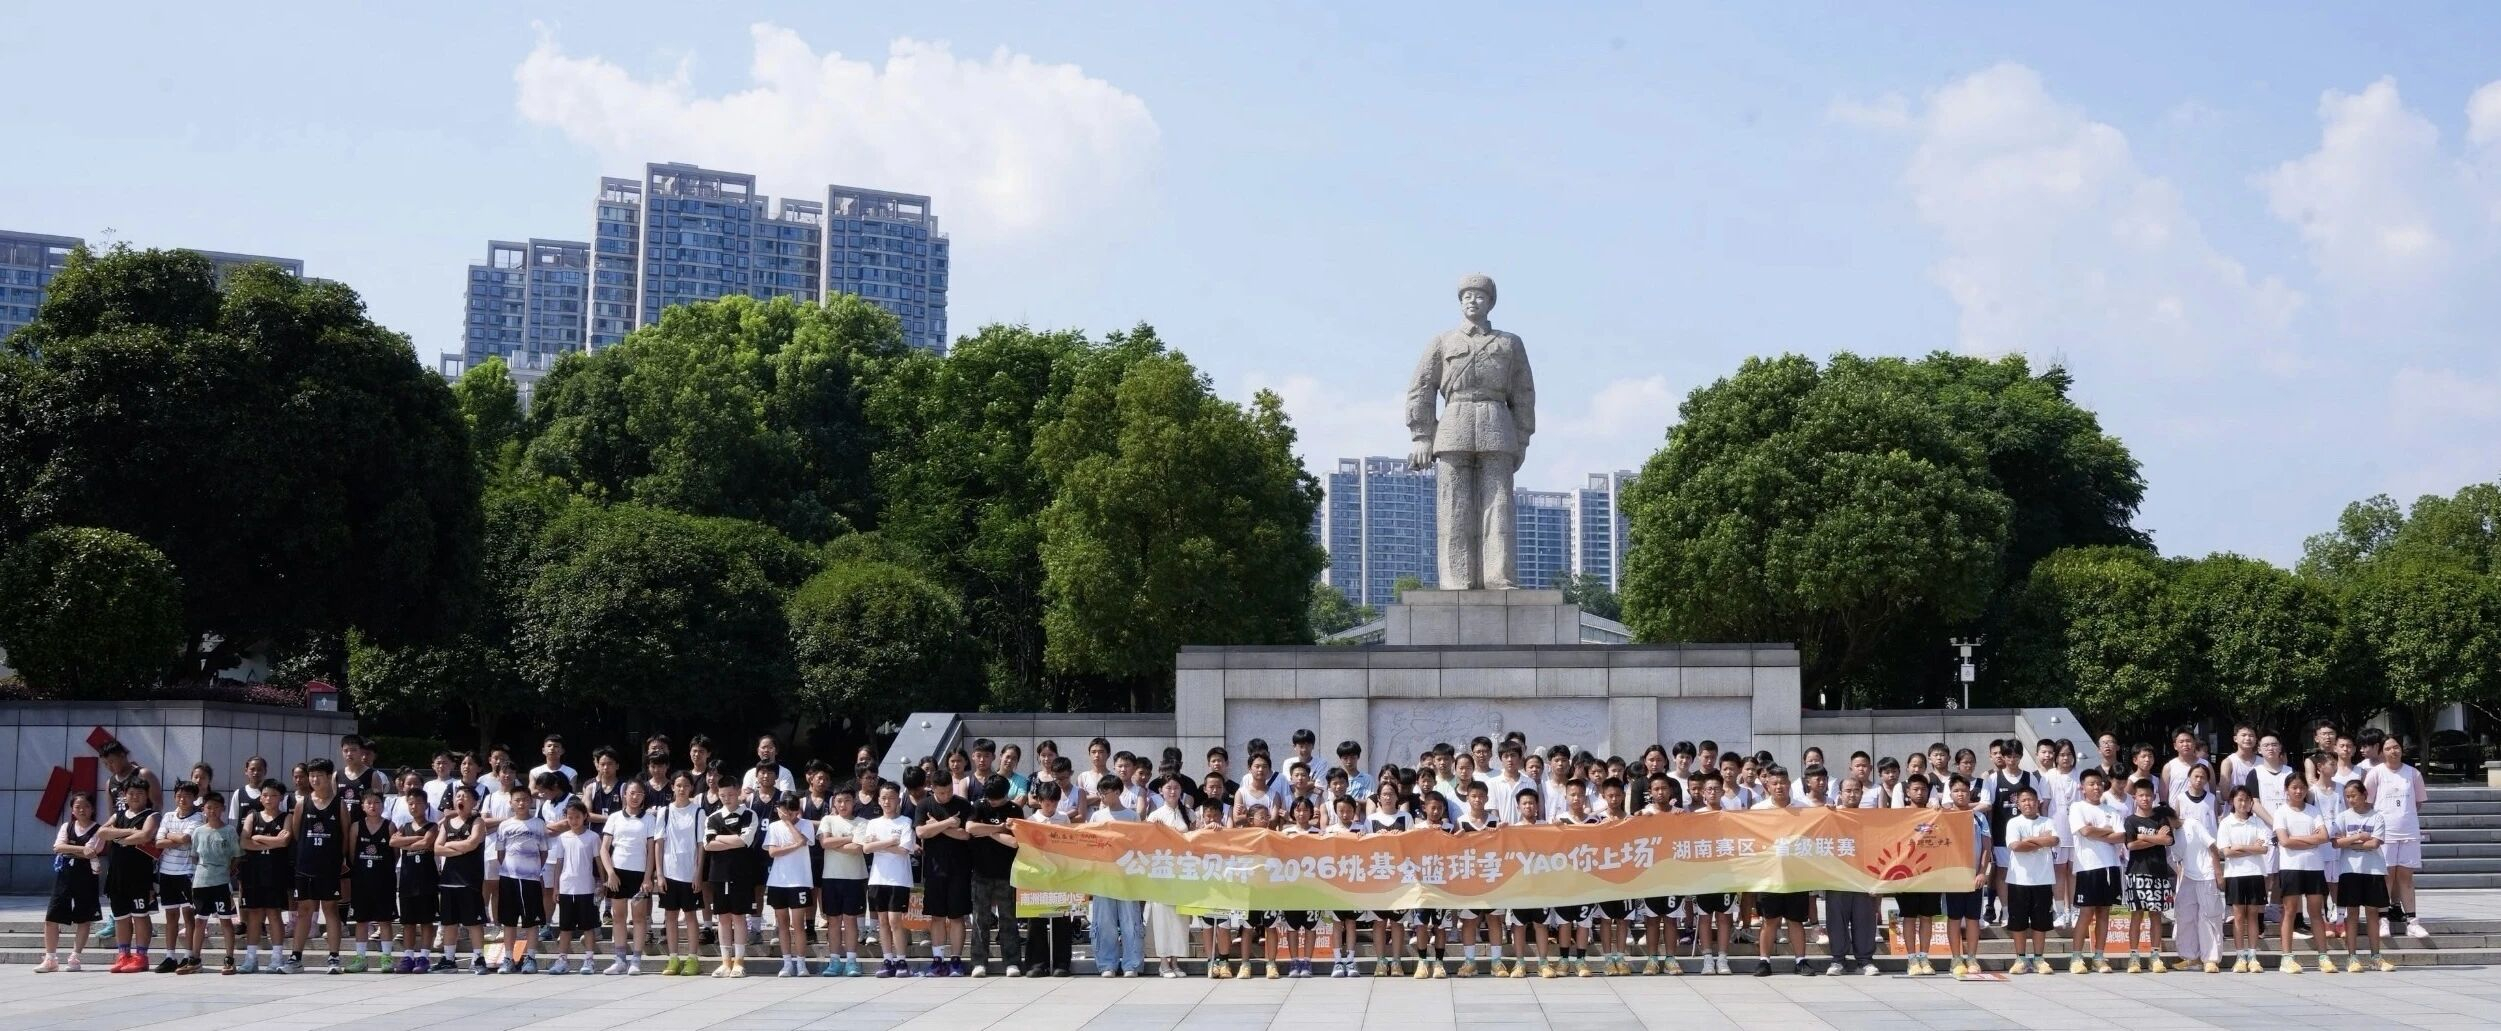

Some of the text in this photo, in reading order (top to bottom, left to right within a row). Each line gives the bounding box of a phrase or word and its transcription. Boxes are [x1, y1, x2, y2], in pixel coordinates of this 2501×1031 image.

[760, 818, 770, 832] 9
[313, 837, 324, 847] 13
[366, 859, 373, 868] 9
[1116, 848, 1255, 883] 公益宝贝杯
[1671, 837, 1857, 861] 湖南赛区·省级联赛
[133, 898, 145, 910] 16
[798, 891, 807, 905] 5
[1667, 896, 1676, 908] 6
[1723, 893, 1731, 907] 8
[214, 901, 226, 913] 12
[1579, 905, 1589, 918] 2
[1623, 899, 1633, 912] 11
